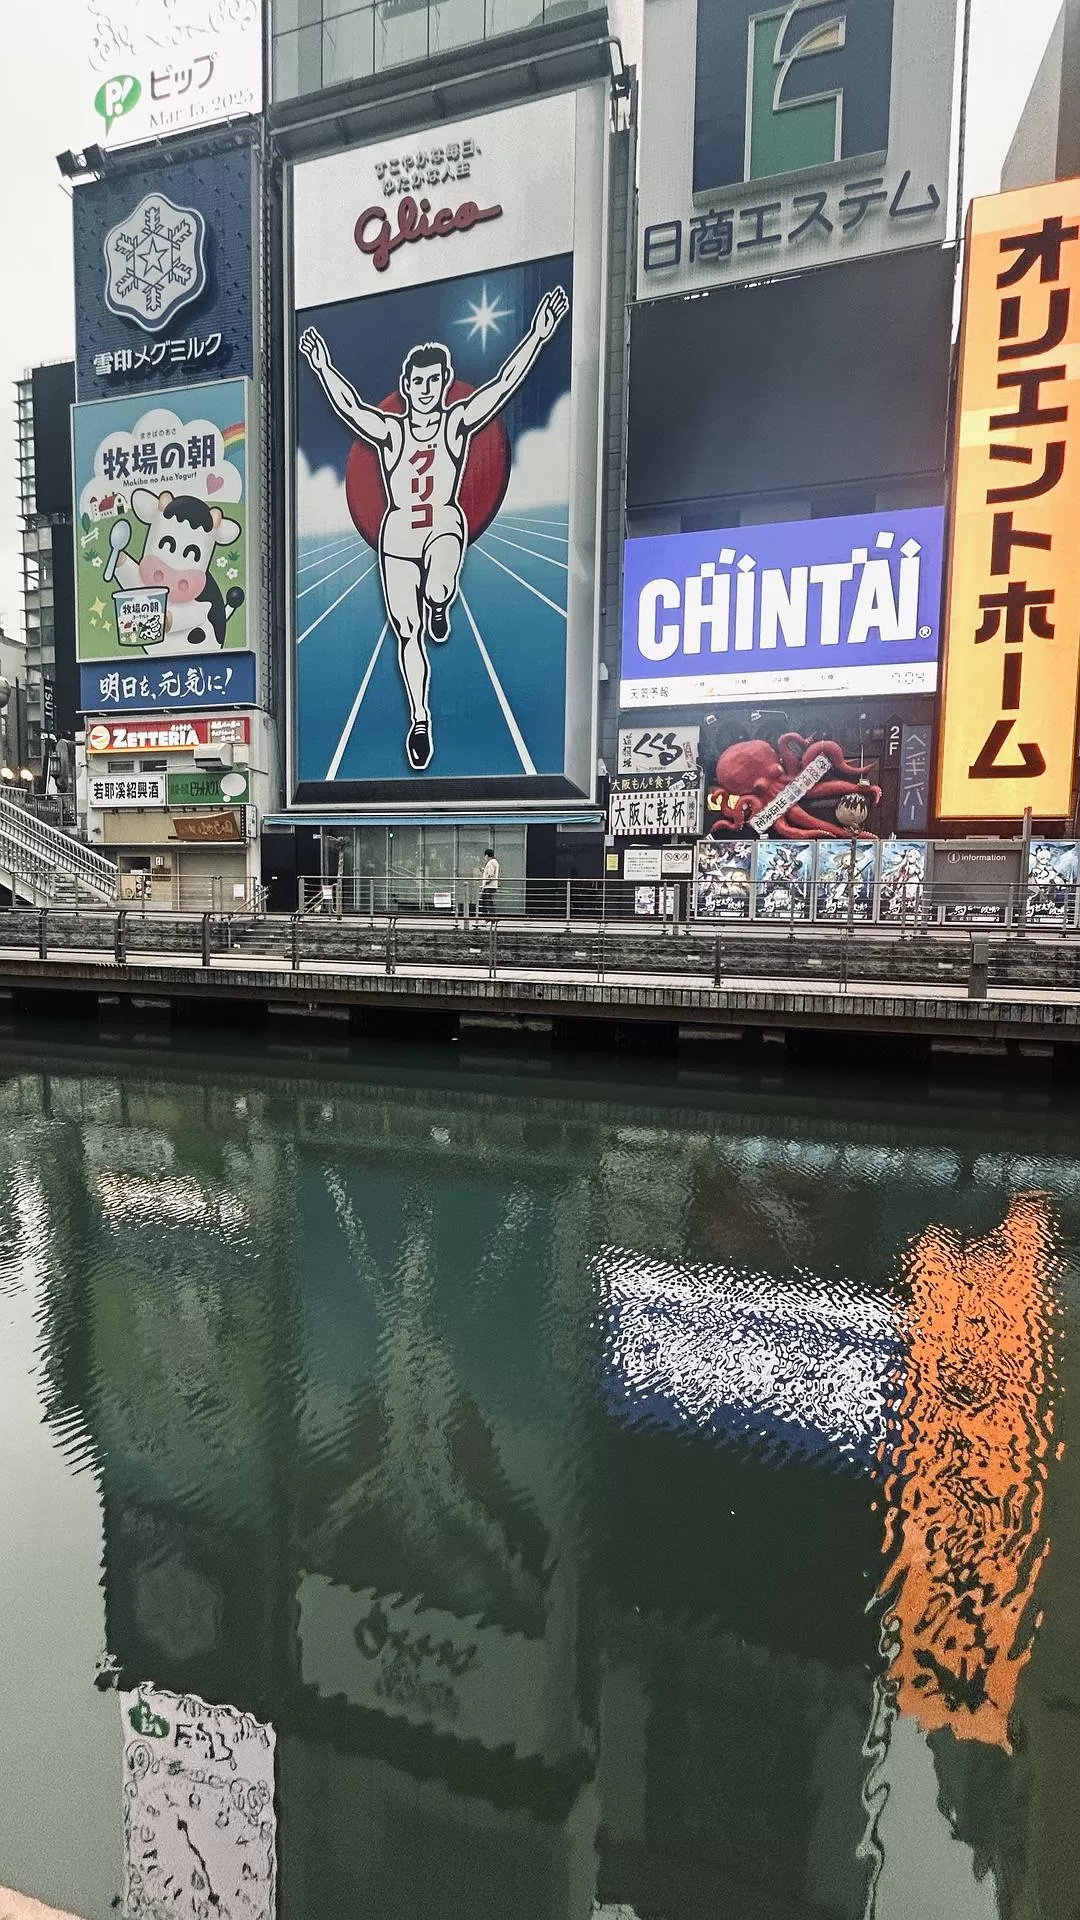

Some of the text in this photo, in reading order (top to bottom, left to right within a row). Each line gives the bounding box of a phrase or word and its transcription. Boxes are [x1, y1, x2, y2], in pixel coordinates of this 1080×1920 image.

[150, 51, 218, 101] ピップ
[643, 169, 941, 272] 日商エステム
[93, 332, 223, 376] 雪印メグミルク
[140, 428, 177, 439] まきばのあさ
[102, 433, 216, 481] 牧場の朝
[174, 471, 197, 481] Yogurt
[408, 443, 437, 530] グリコ
[967, 215, 1080, 780] オリエントホーム
[122, 601, 159, 615] 牧場の朝
[630, 686, 669, 699] 天気予報
[112, 728, 200, 748] ZETTERIA
[632, 732, 684, 766] くくる
[888, 725, 900, 756] 2F
[686, 781, 698, 789] 2F
[903, 733, 928, 820] ペンギンバー
[614, 798, 685, 828] 大阪に乾杯
[961, 853, 1006, 861] information
